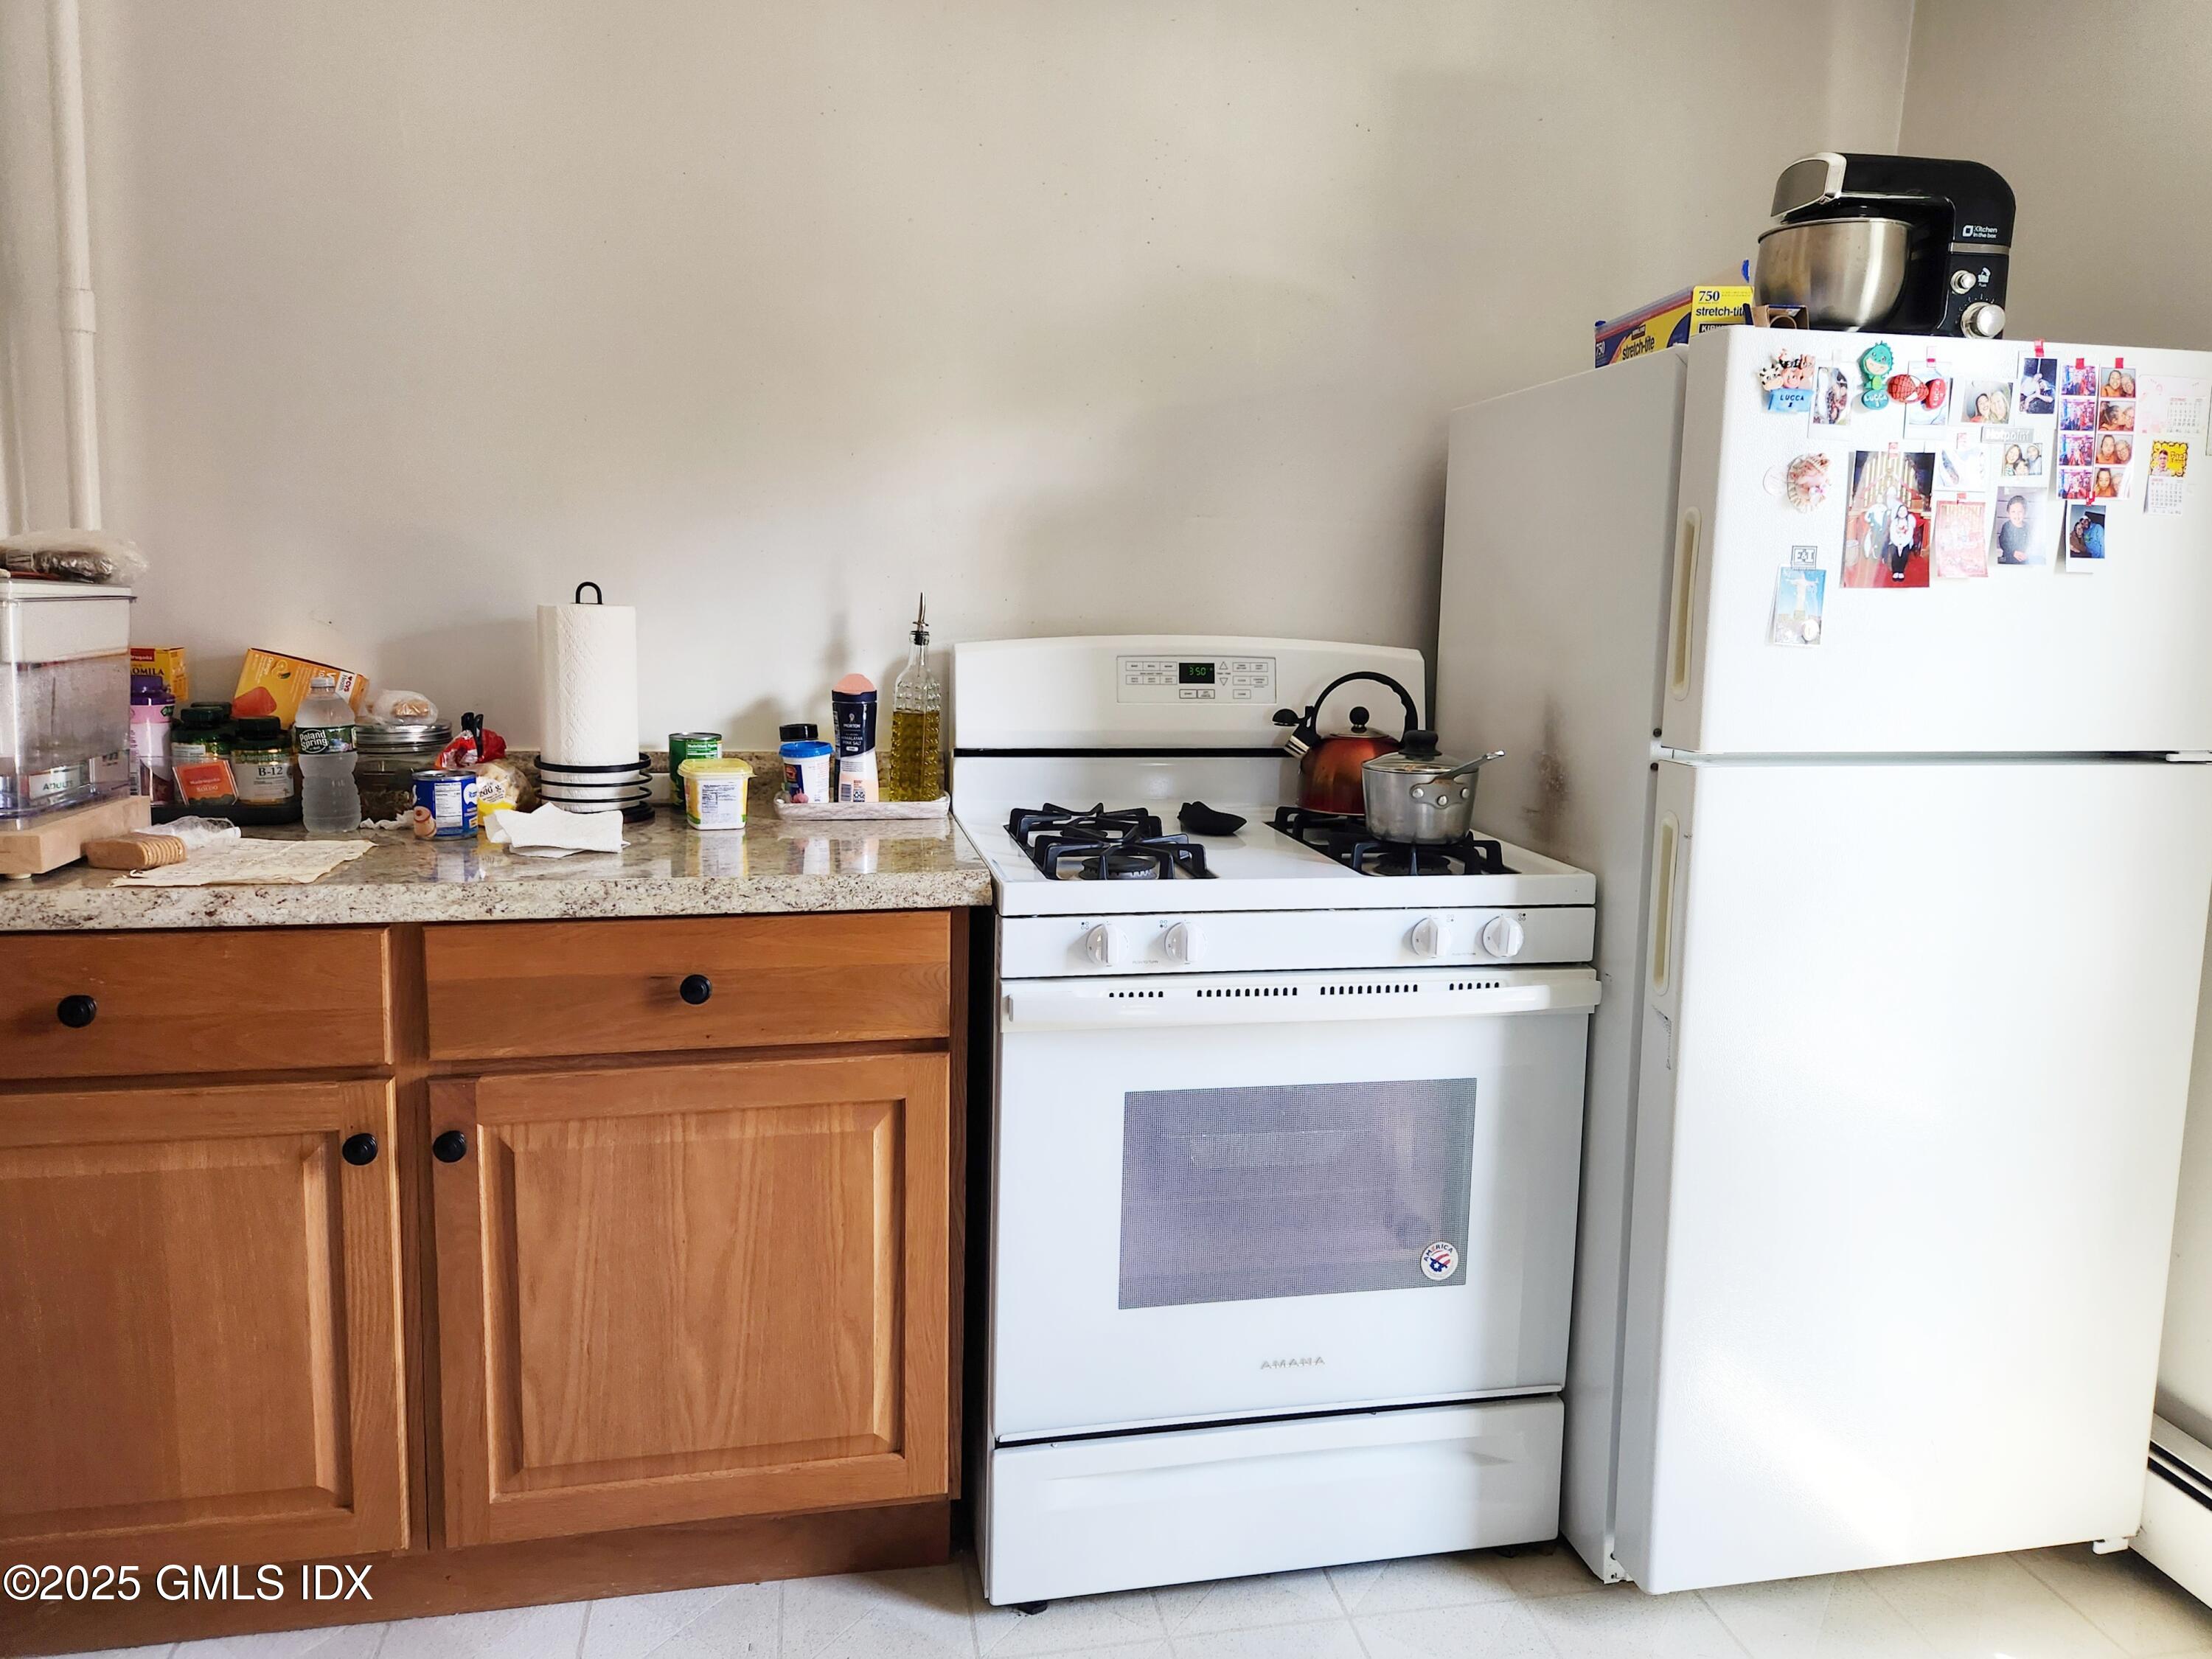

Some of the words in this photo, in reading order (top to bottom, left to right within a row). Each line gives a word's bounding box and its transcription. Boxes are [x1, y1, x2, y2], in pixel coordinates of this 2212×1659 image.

[1974, 225, 1997, 233] Kitchen
[1698, 290, 1720, 302] 750
[1622, 336, 1655, 360] stretch-tite
[1779, 394, 1805, 402] LUCCA
[1863, 393, 1888, 402] LUCCA
[1932, 380, 1942, 406] LUCCA
[131, 667, 164, 676] OMILA
[344, 681, 352, 693] CVS
[299, 729, 327, 742] Poland
[300, 737, 329, 751] Spring
[258, 766, 283, 777] B-12
[1423, 1243, 1453, 1262] AMERICA
[1259, 1356, 1326, 1370] AMANA
